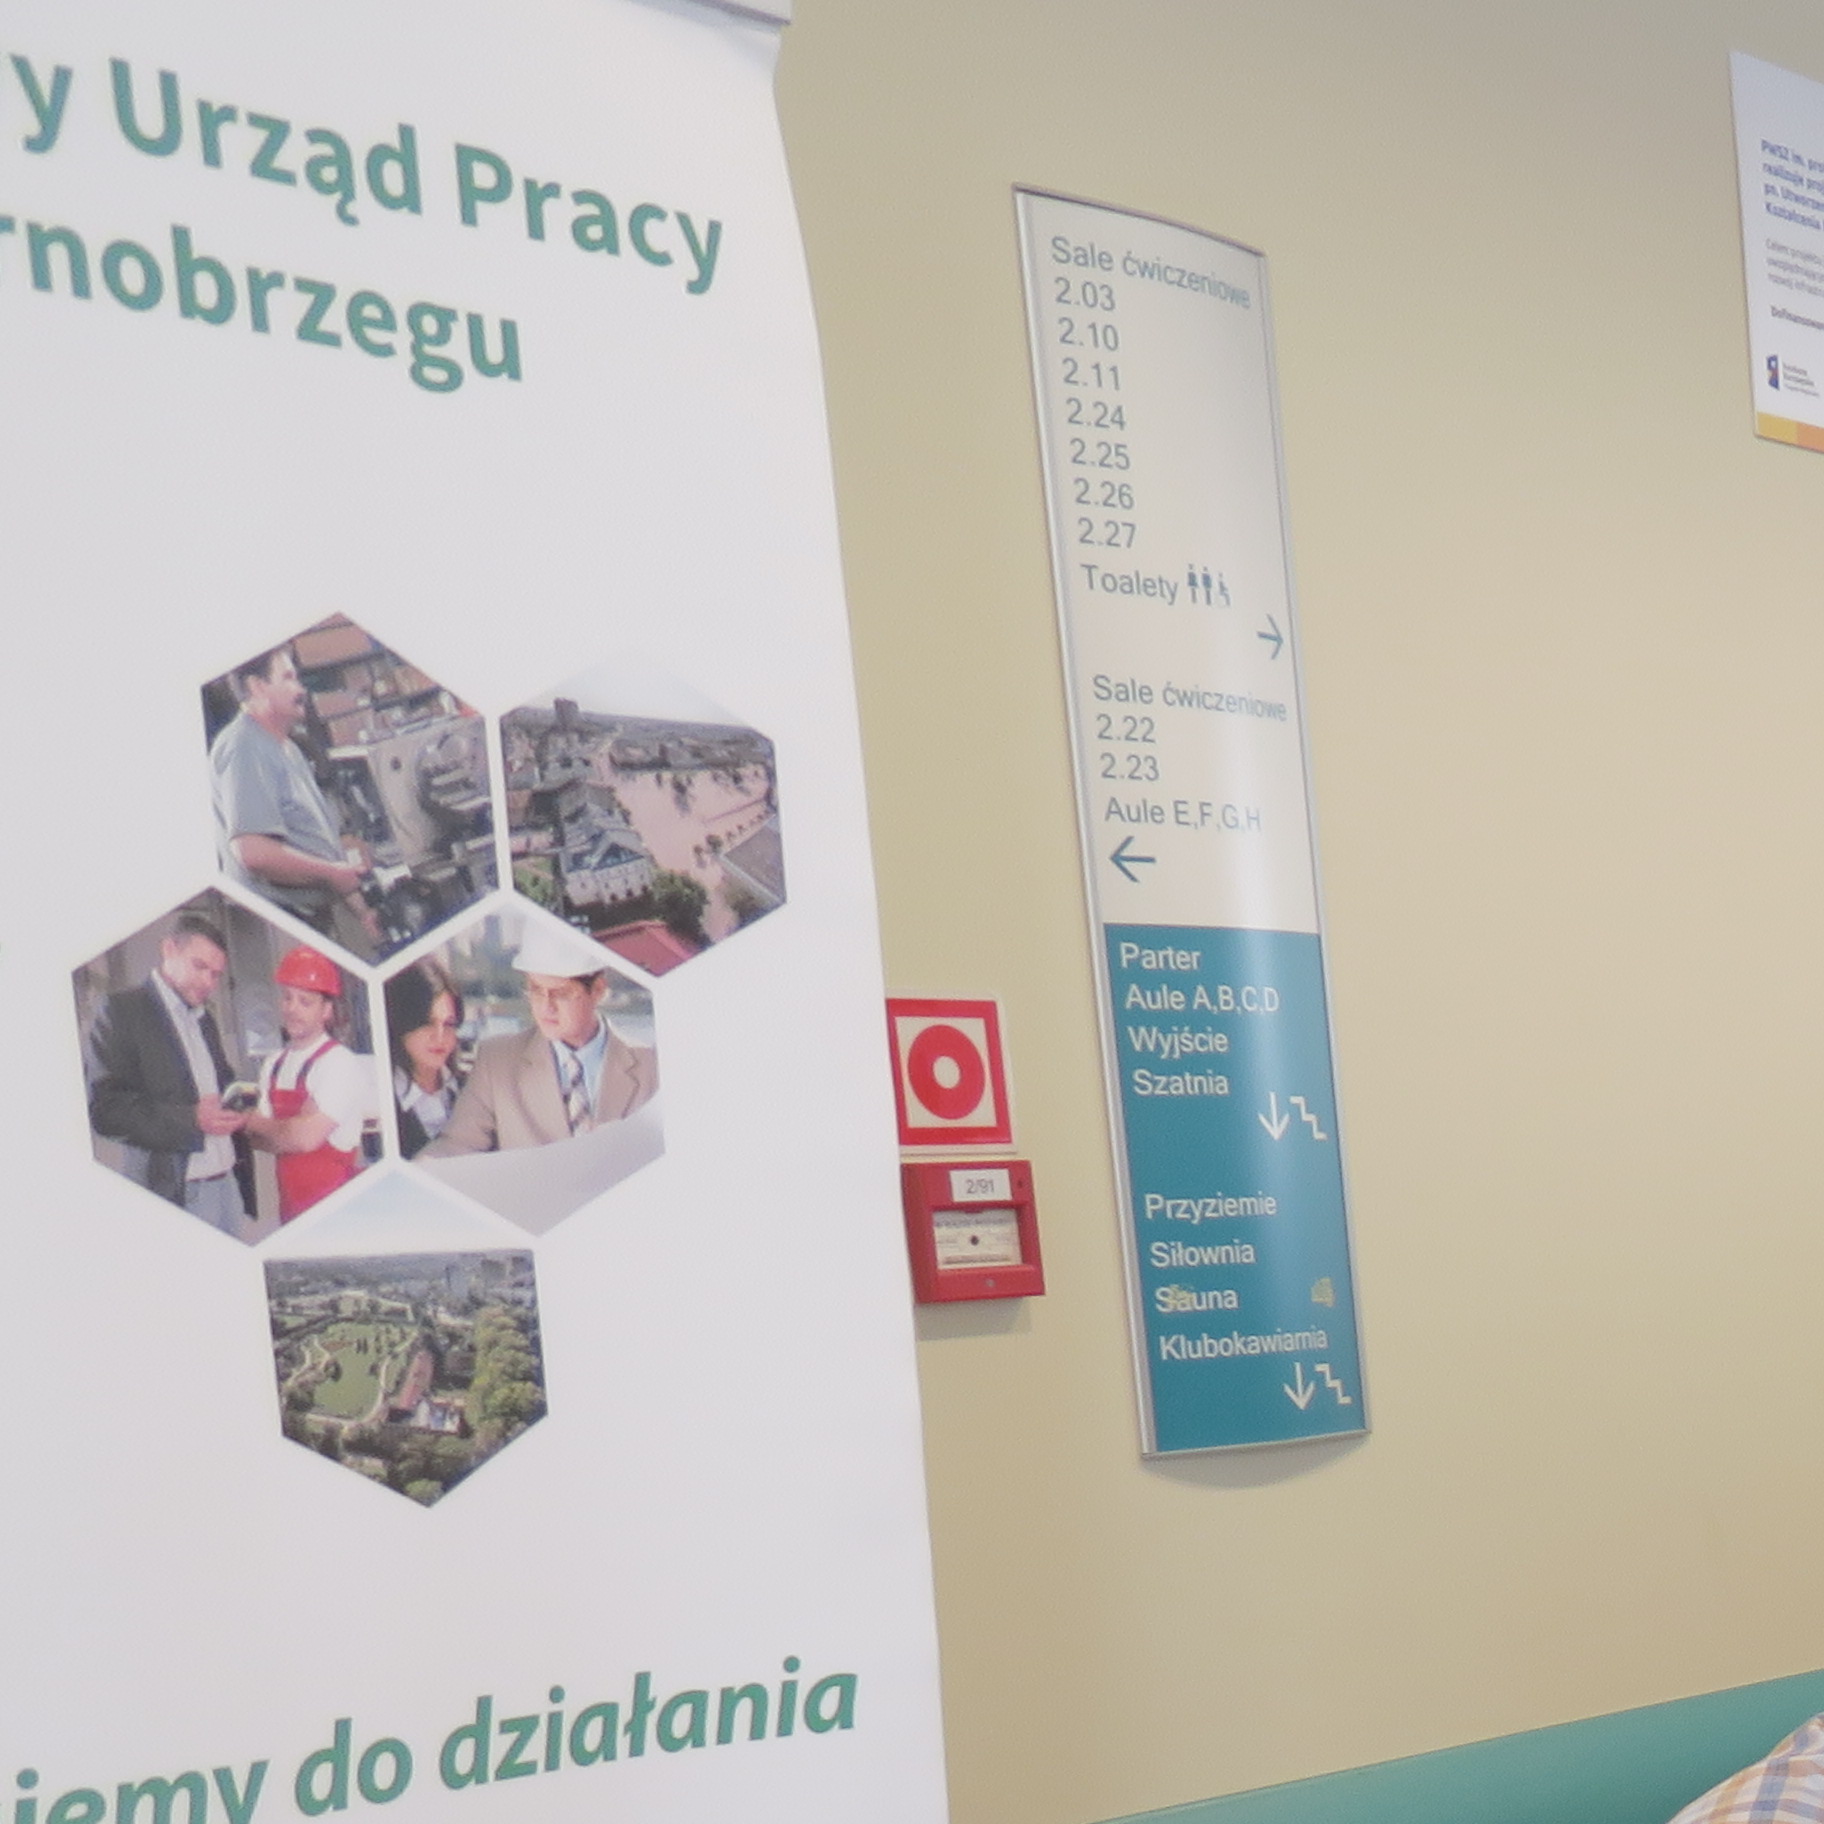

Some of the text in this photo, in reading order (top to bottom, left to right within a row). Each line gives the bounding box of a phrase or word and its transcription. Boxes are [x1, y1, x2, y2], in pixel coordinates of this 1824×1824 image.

[108, 57, 425, 226] Urząd
[453, 142, 723, 296] Pracy
[1051, 236, 1252, 310] Sale ćwiczeniowe
[0, 212, 523, 395] nobrzegu
[1054, 276, 1116, 312] 2.03
[1057, 316, 1119, 352] 2.10
[1061, 357, 1122, 391] 2.11
[1066, 397, 1127, 431] 2.24
[1069, 437, 1130, 472] 2.25
[1073, 477, 1135, 511] 2.26
[1077, 517, 1138, 550] 2.27
[1080, 563, 1179, 607] Toalety
[1092, 674, 1288, 722] Sale ćwiczeniowe
[1096, 713, 1157, 744] 2.22
[1100, 752, 1160, 782] 2.23
[1104, 796, 1166, 825] Aule
[1119, 943, 1202, 971] Parter
[1125, 985, 1281, 1016] Aule A,B,C,D
[1128, 1026, 1230, 1060] Wyjście
[1133, 1068, 1231, 1098] Szatnia
[1144, 1191, 1278, 1225] Przyziemie
[1150, 1239, 1257, 1268] Siłownia
[1155, 1285, 1240, 1313] Sauna
[1159, 1324, 1329, 1360] Klubokawiarnia
[294, 1717, 412, 1816] do
[438, 1655, 858, 1791] działania
